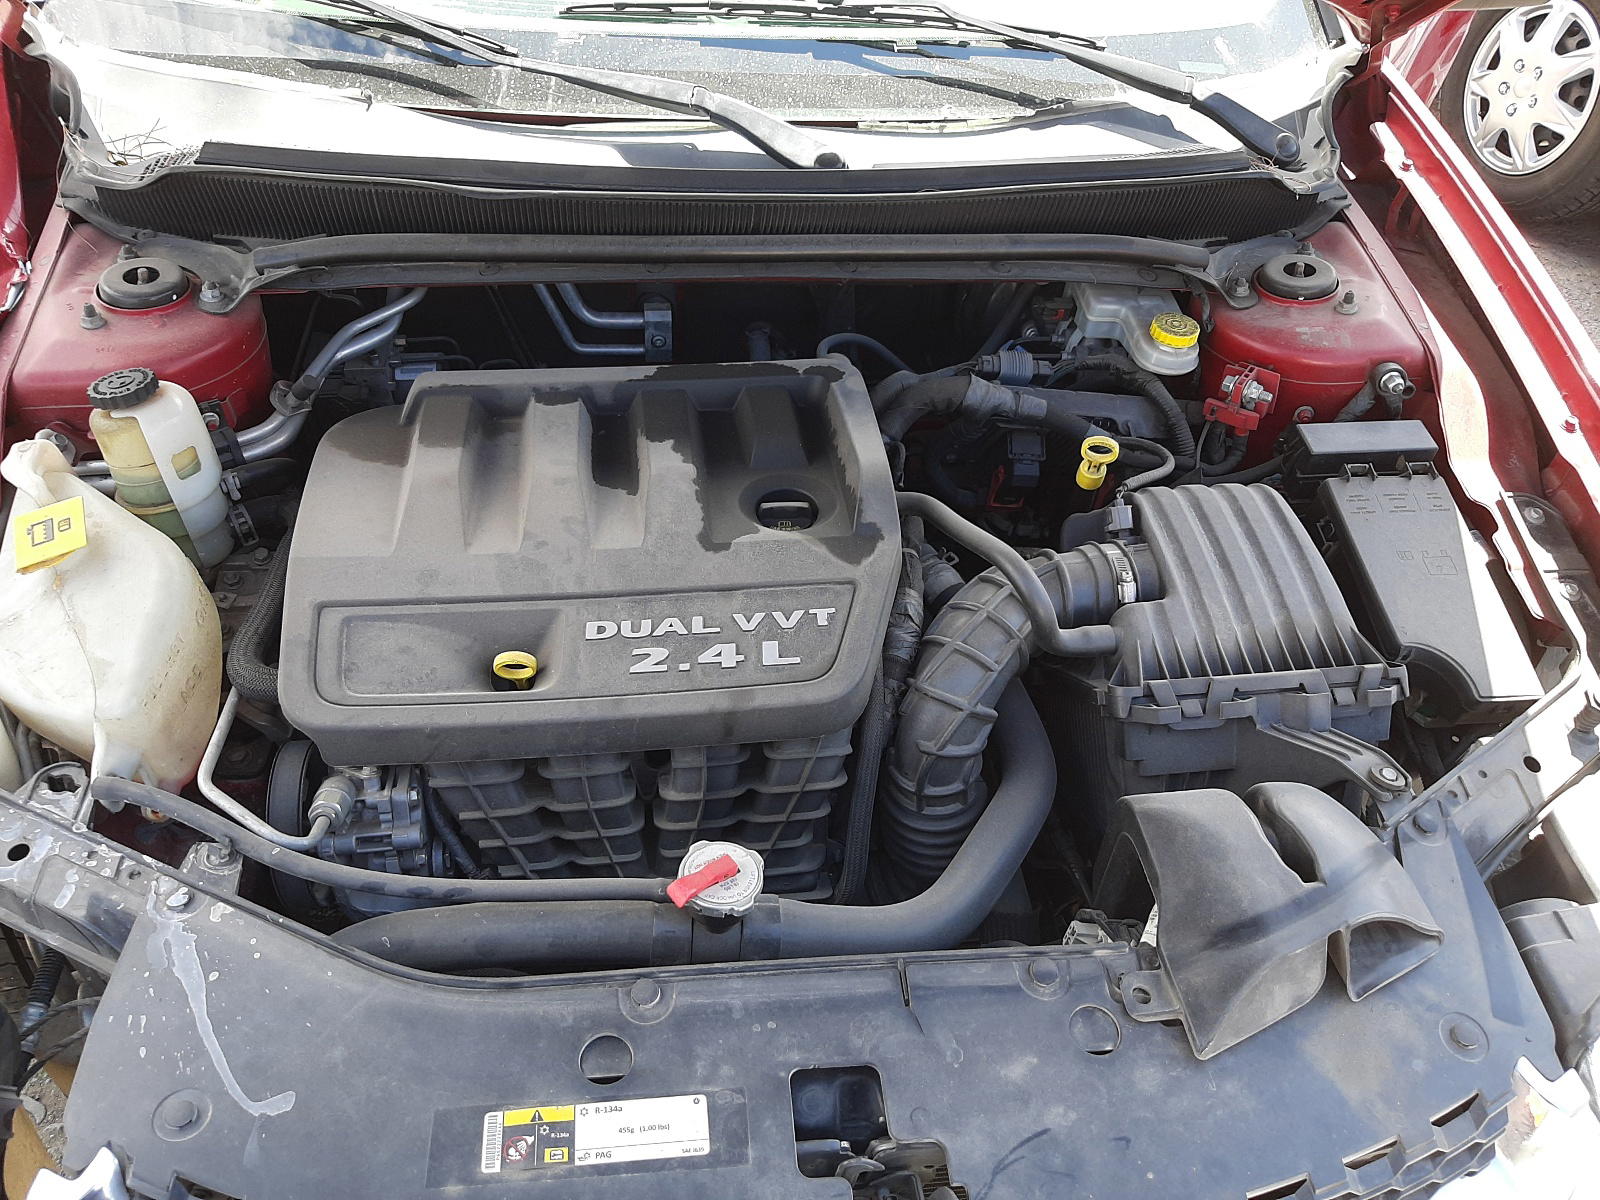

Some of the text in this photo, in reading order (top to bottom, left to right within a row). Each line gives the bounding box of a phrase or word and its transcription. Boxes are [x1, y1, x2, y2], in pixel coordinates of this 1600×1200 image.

[585, 607, 836, 640] DUAL VVT
[629, 640, 801, 674] 2.4 L
[595, 1105, 623, 1114] R-134a
[618, 1126, 635, 1134] 455g
[639, 1124, 657, 1133] (1.00
[595, 1151, 612, 1160] PAG
